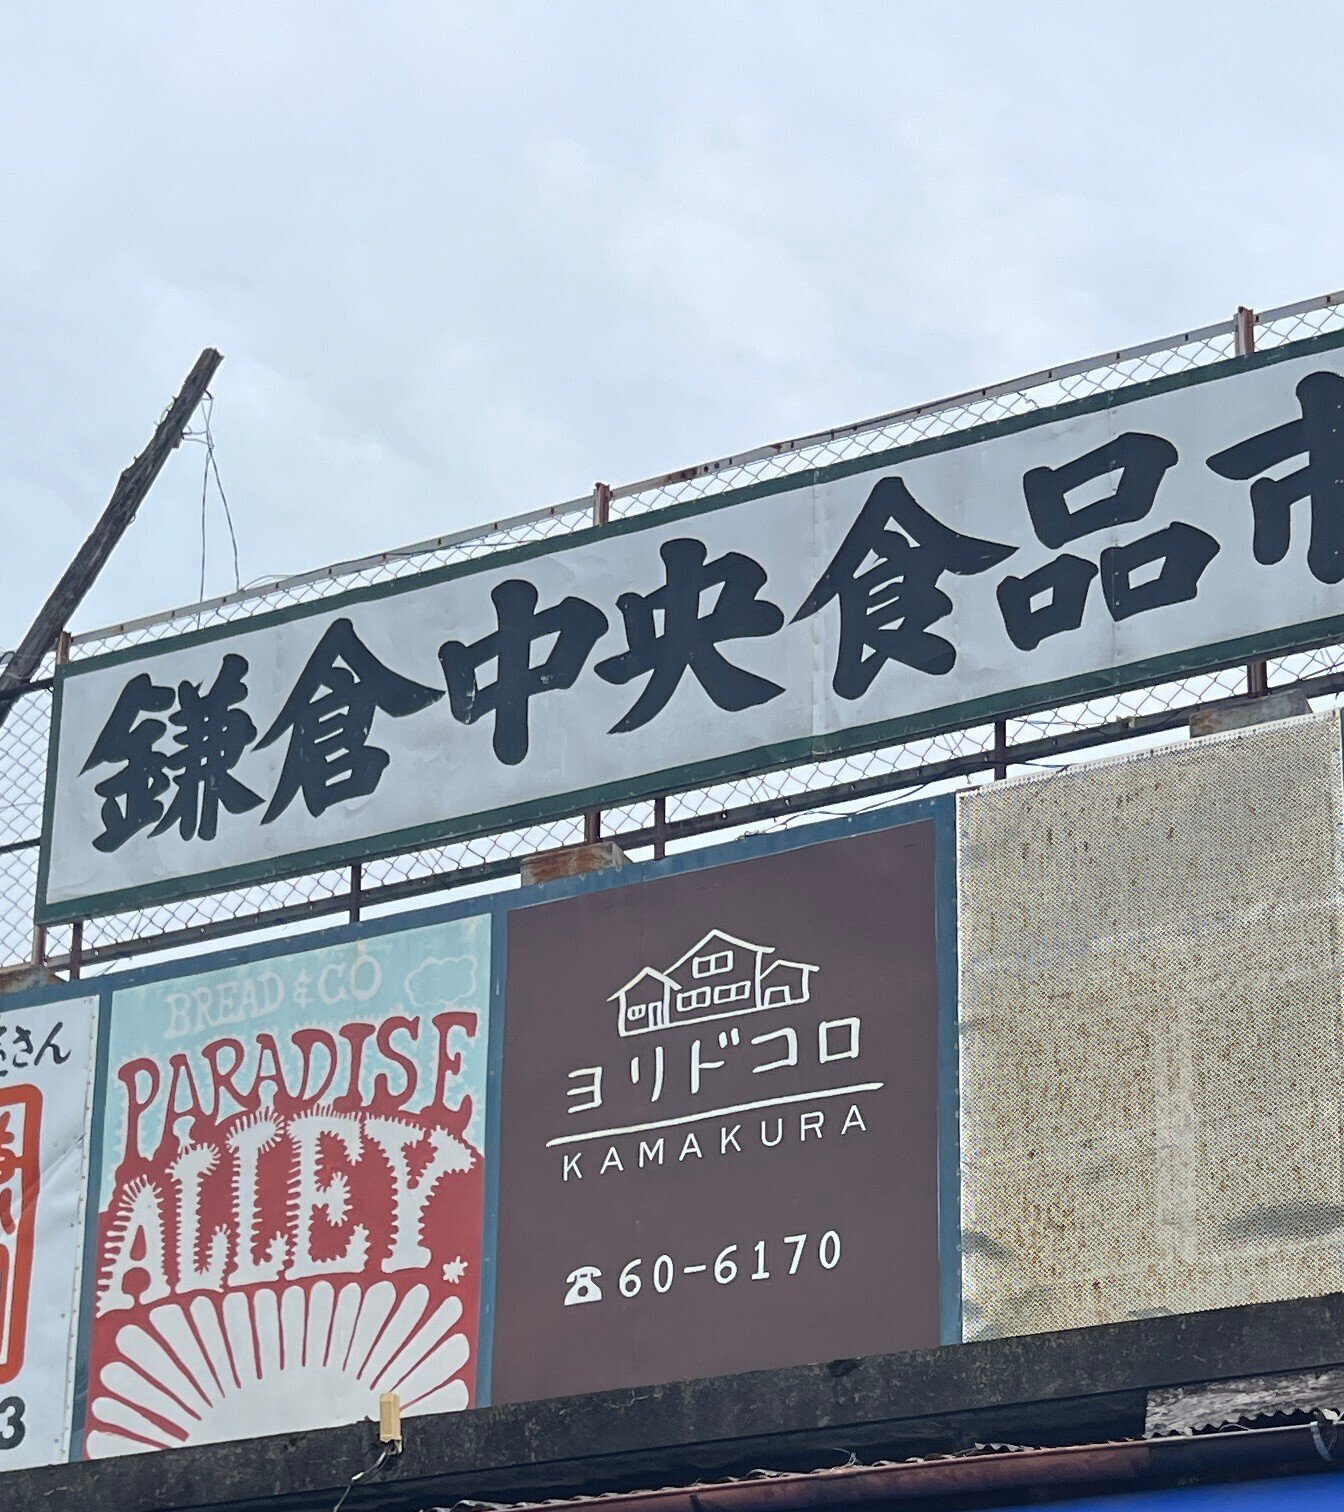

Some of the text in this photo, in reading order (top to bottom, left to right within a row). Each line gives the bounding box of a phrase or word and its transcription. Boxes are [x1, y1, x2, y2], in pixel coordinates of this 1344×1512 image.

[164, 971, 285, 1039] BREAD
[292, 968, 313, 1008] &
[117, 1010, 481, 1159] PARADISE
[565, 1016, 862, 1115] ヨリドコロ
[561, 1103, 868, 1183] KAMAKURA
[617, 1229, 843, 1298] 60-6170
